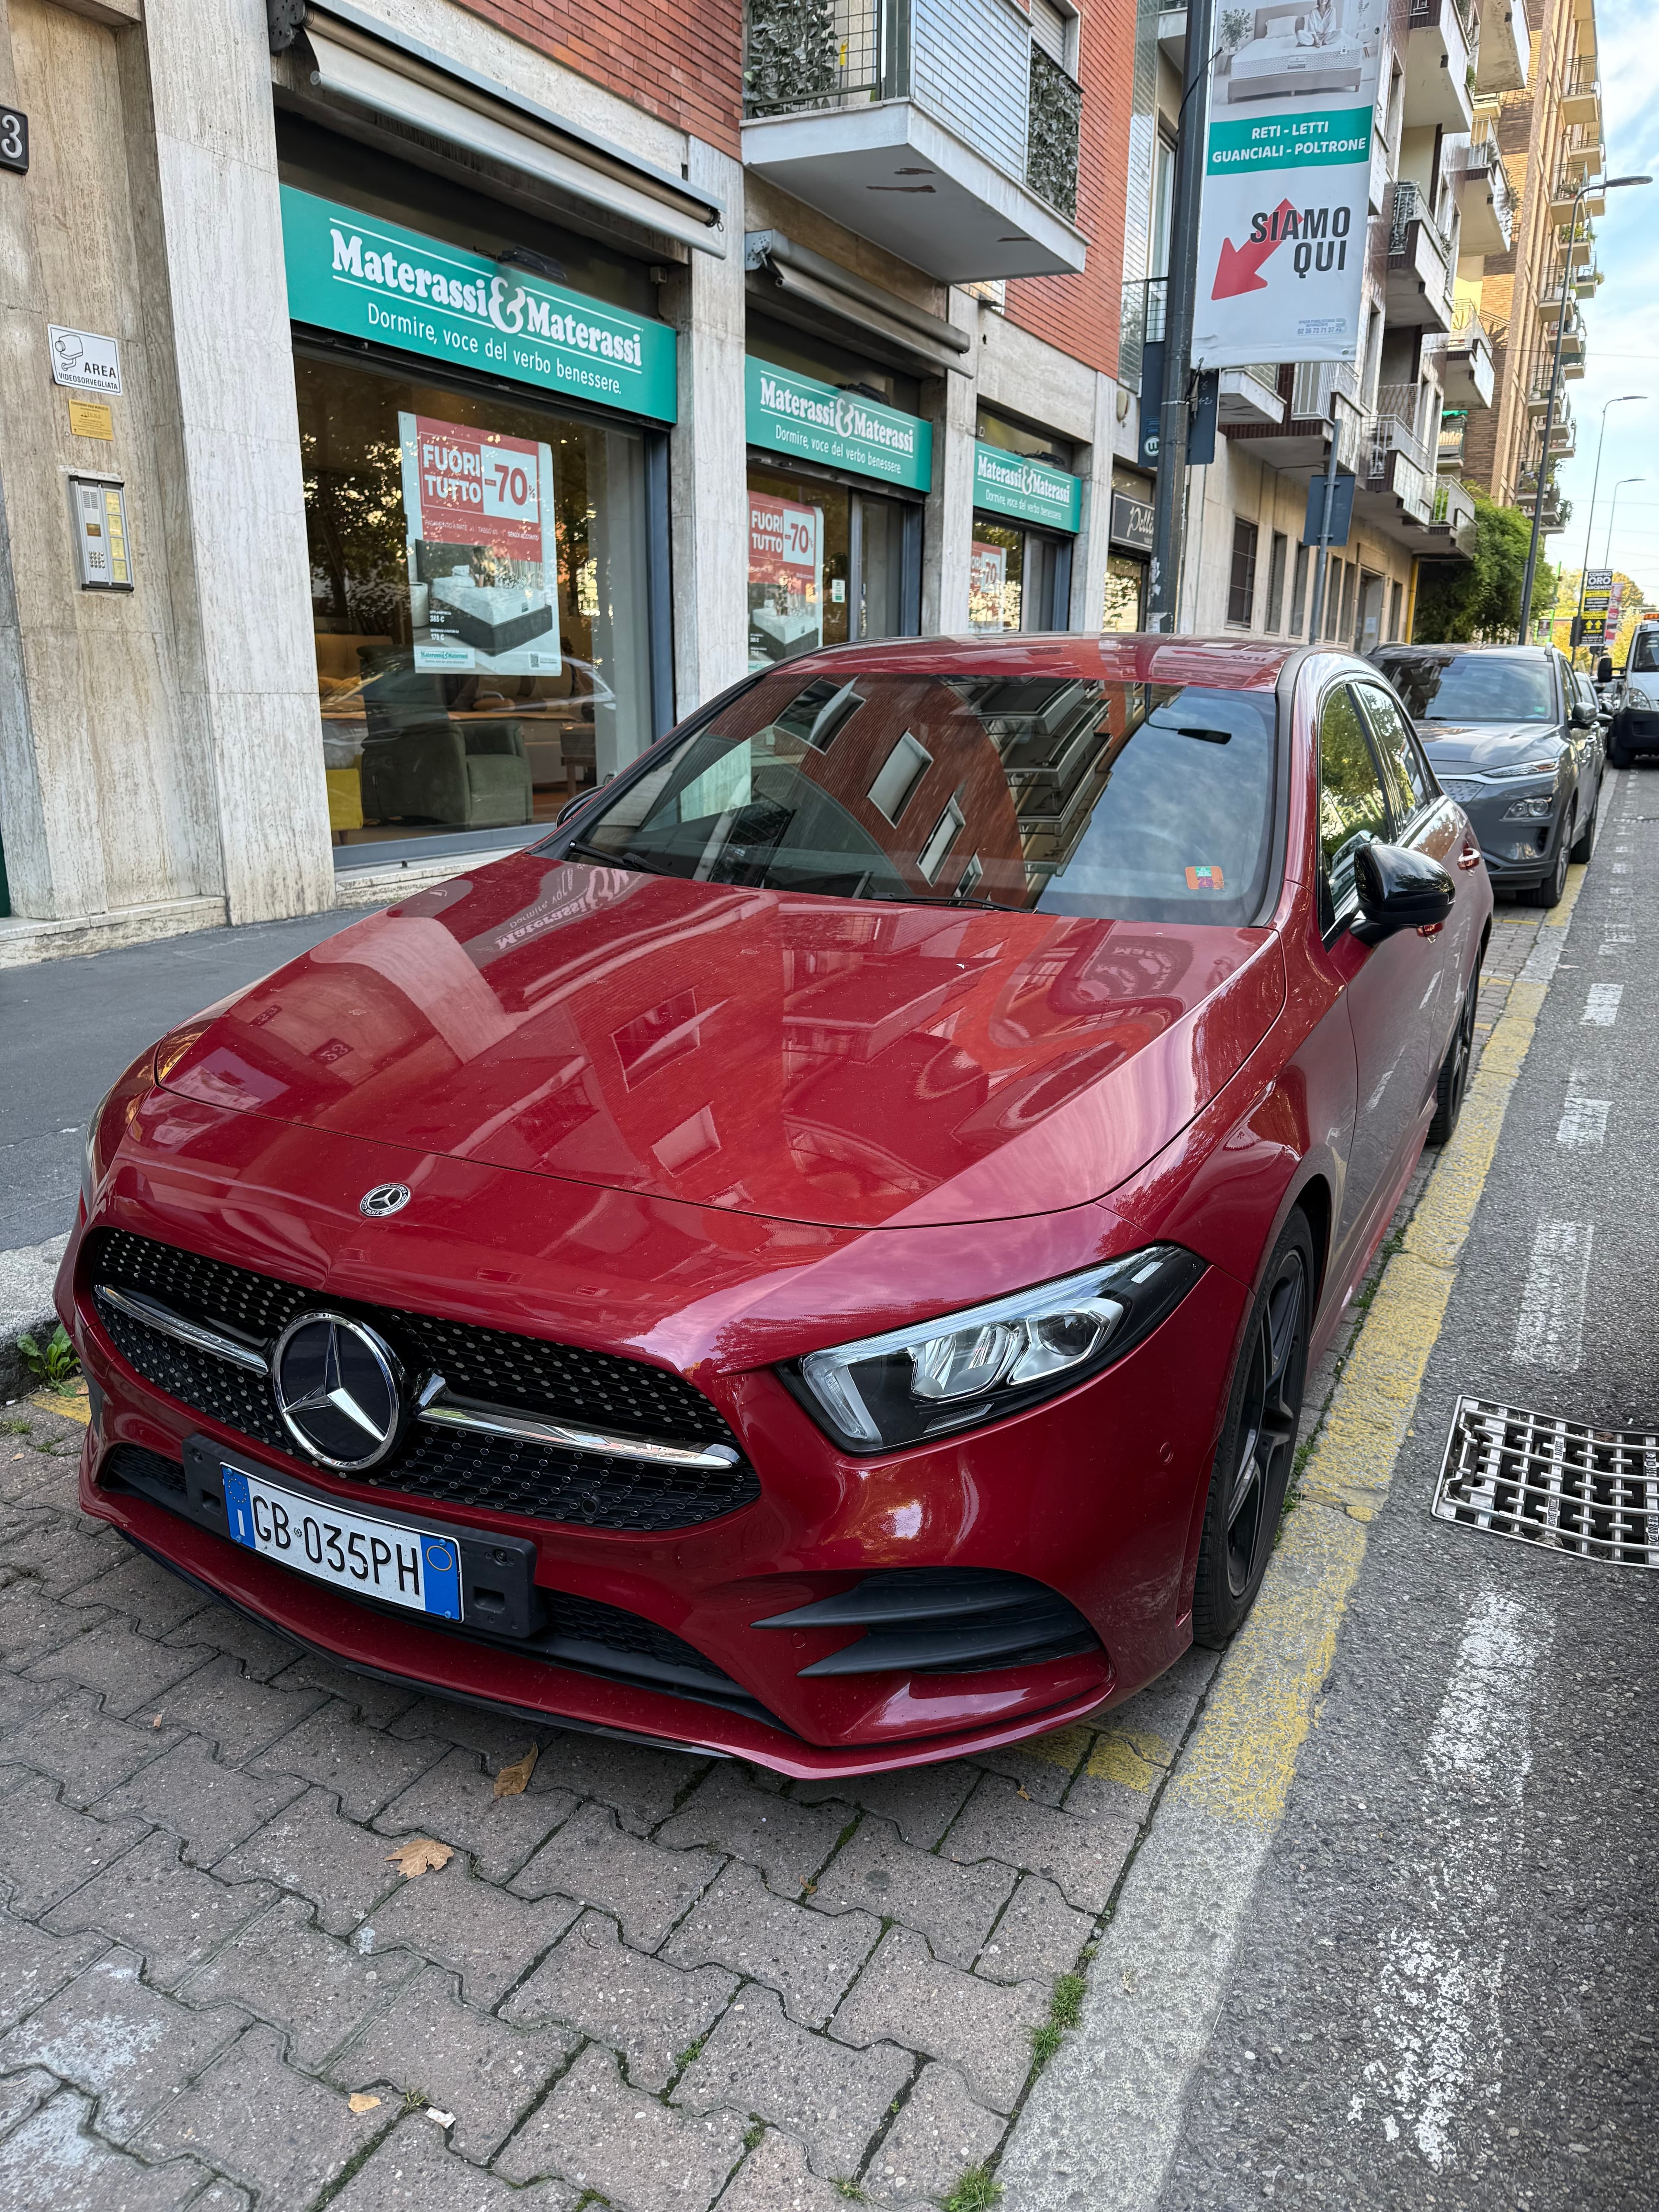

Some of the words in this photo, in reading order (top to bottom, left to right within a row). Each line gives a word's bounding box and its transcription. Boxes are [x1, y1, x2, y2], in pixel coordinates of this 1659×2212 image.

[1, 114, 22, 159] 3
[1252, 125, 1281, 139] RETI
[1292, 121, 1329, 136] LETTI
[1213, 144, 1284, 163] GUANCIALI
[1295, 137, 1367, 154] POLTRONE
[1250, 206, 1351, 243] SIAMO
[1294, 240, 1347, 278] QUI
[331, 229, 488, 317] Materassi
[488, 276, 525, 334] &
[527, 298, 642, 366] Materassi
[369, 302, 437, 344] Dormire,
[443, 330, 478, 353] voce
[485, 337, 508, 360] del
[512, 348, 551, 374] verbo
[556, 358, 621, 394] benessere.
[58, 372, 118, 390] VIDEOSORVEGLIATA
[84, 362, 116, 378] AREA
[760, 377, 834, 427] Materassi
[834, 398, 854, 437] &
[854, 410, 913, 453] Materassi
[423, 443, 481, 477] FUORI
[775, 425, 809, 450] Dormire,
[811, 438, 829, 453] voce
[832, 442, 843, 457] del
[846, 448, 866, 464] verbo
[868, 451, 902, 474] benessere.
[424, 474, 481, 503] TUTTO
[977, 455, 1022, 488] Materassi
[1021, 465, 1033, 495] &
[1033, 473, 1070, 503] Materassi
[751, 510, 783, 534] FUORI
[752, 533, 782, 553] TUTTO
[1588, 576, 1611, 585] ORO
